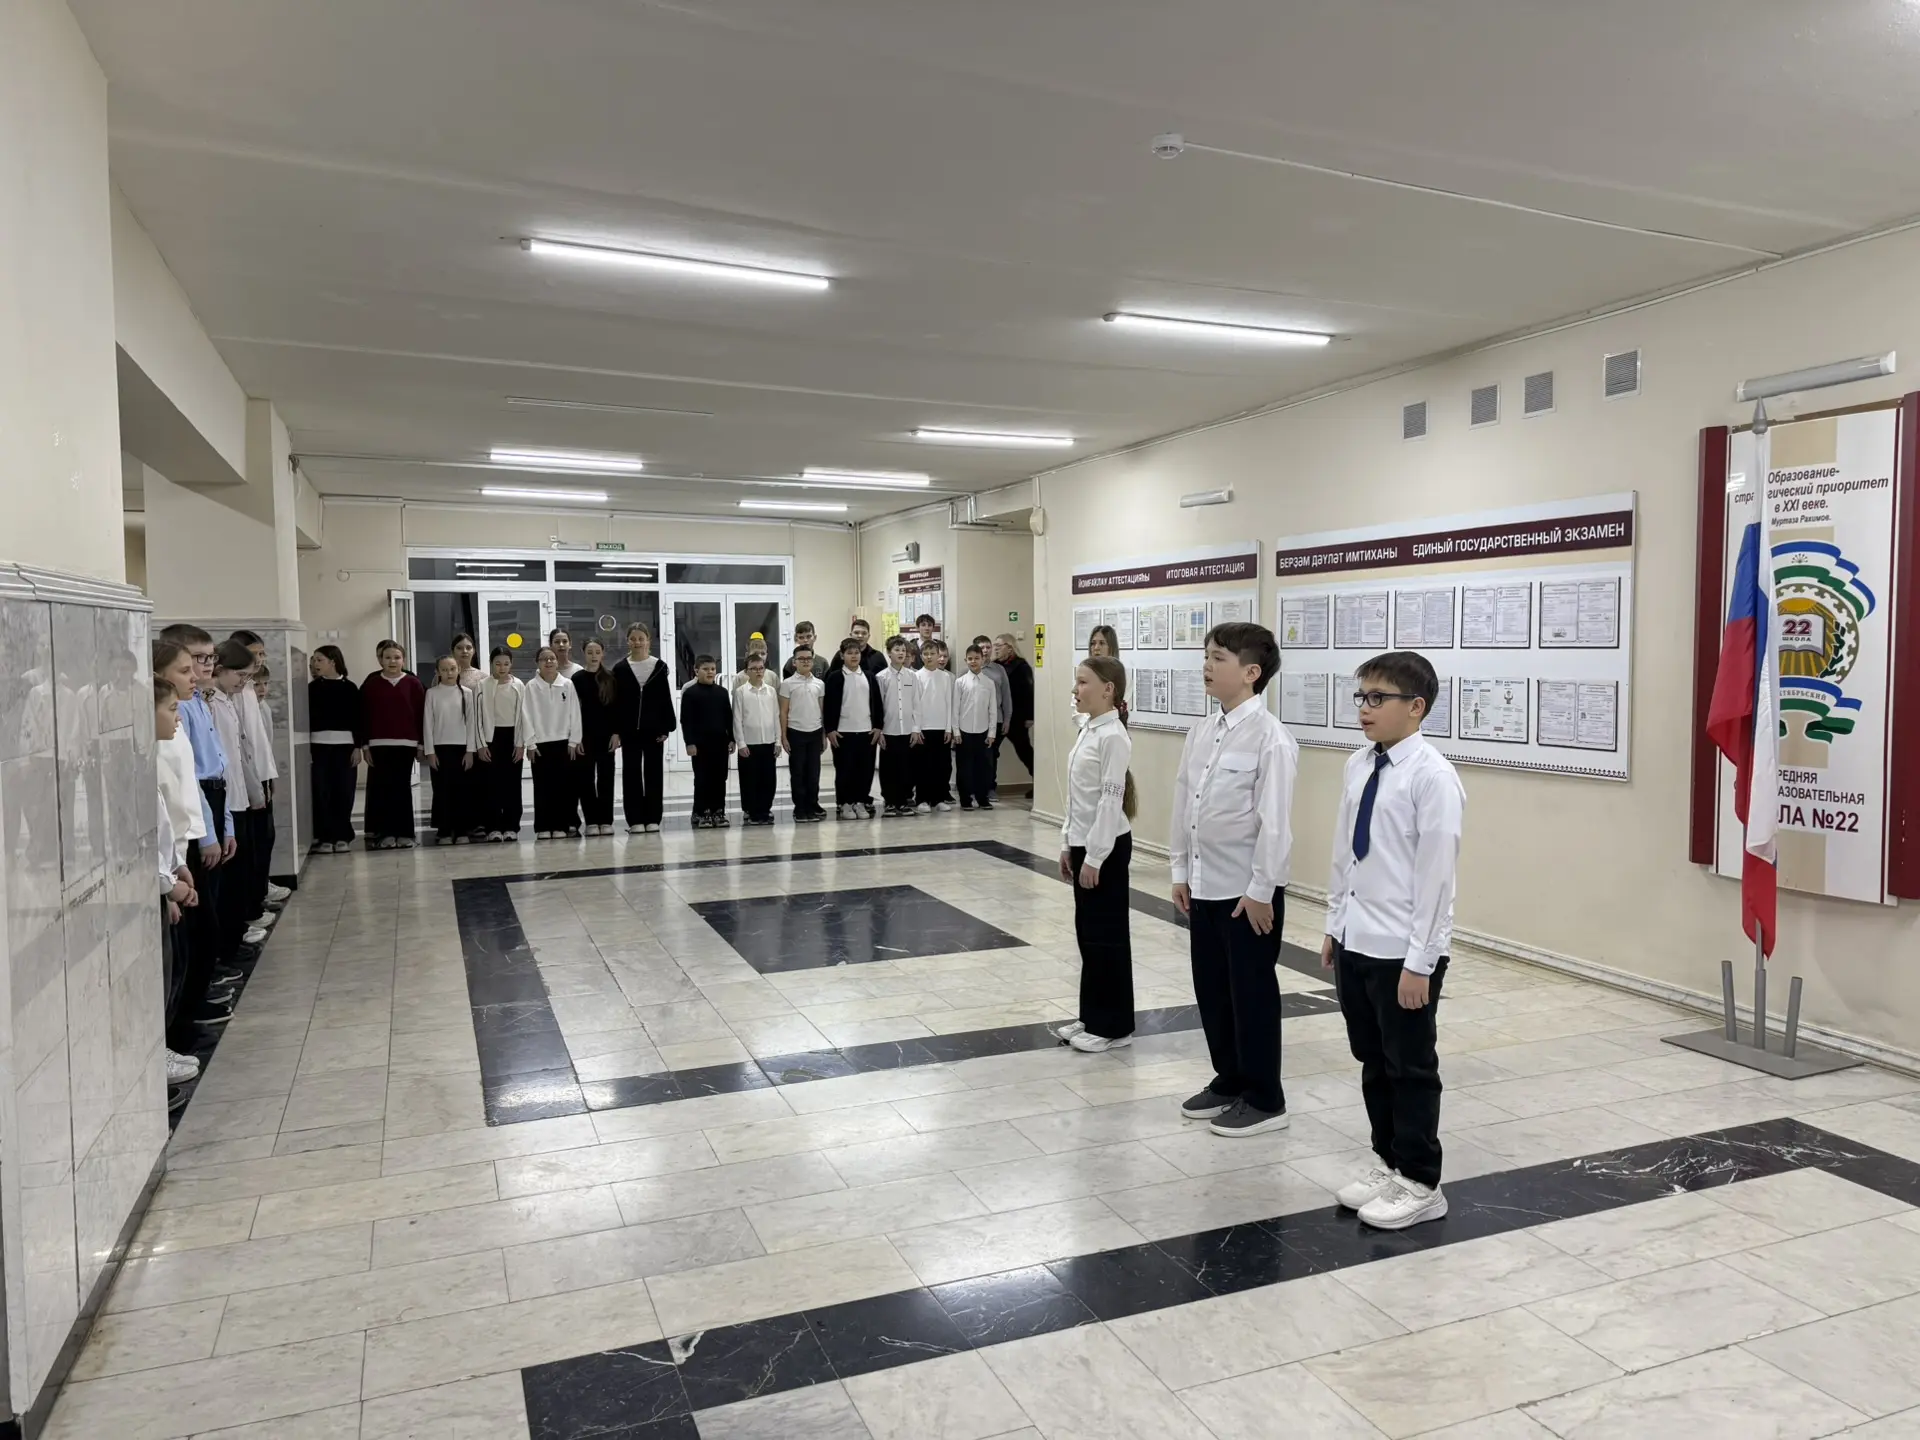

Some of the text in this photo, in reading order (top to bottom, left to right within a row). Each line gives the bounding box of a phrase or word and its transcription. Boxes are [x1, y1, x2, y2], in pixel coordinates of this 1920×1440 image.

[1768, 467, 1840, 485] Образование-
[1816, 477, 1889, 496] приоритет
[1774, 499, 1828, 513] в XXI веке.
[1771, 517, 1799, 527] Муртаза
[1345, 547, 1398, 563] ИМТИХАНЫ
[1412, 538, 1452, 558] ЕДИНЫЙ
[1455, 527, 1562, 552] ГОСУДАРСТВЕННЫЙ
[1564, 522, 1625, 542] ЭКЗАМЕН
[1166, 567, 1198, 579] ИТОГОВАЯ
[1200, 562, 1245, 576] АТТЕСТАЦИЯ
[1782, 619, 1812, 636] 22
[1812, 808, 1859, 833] №22
